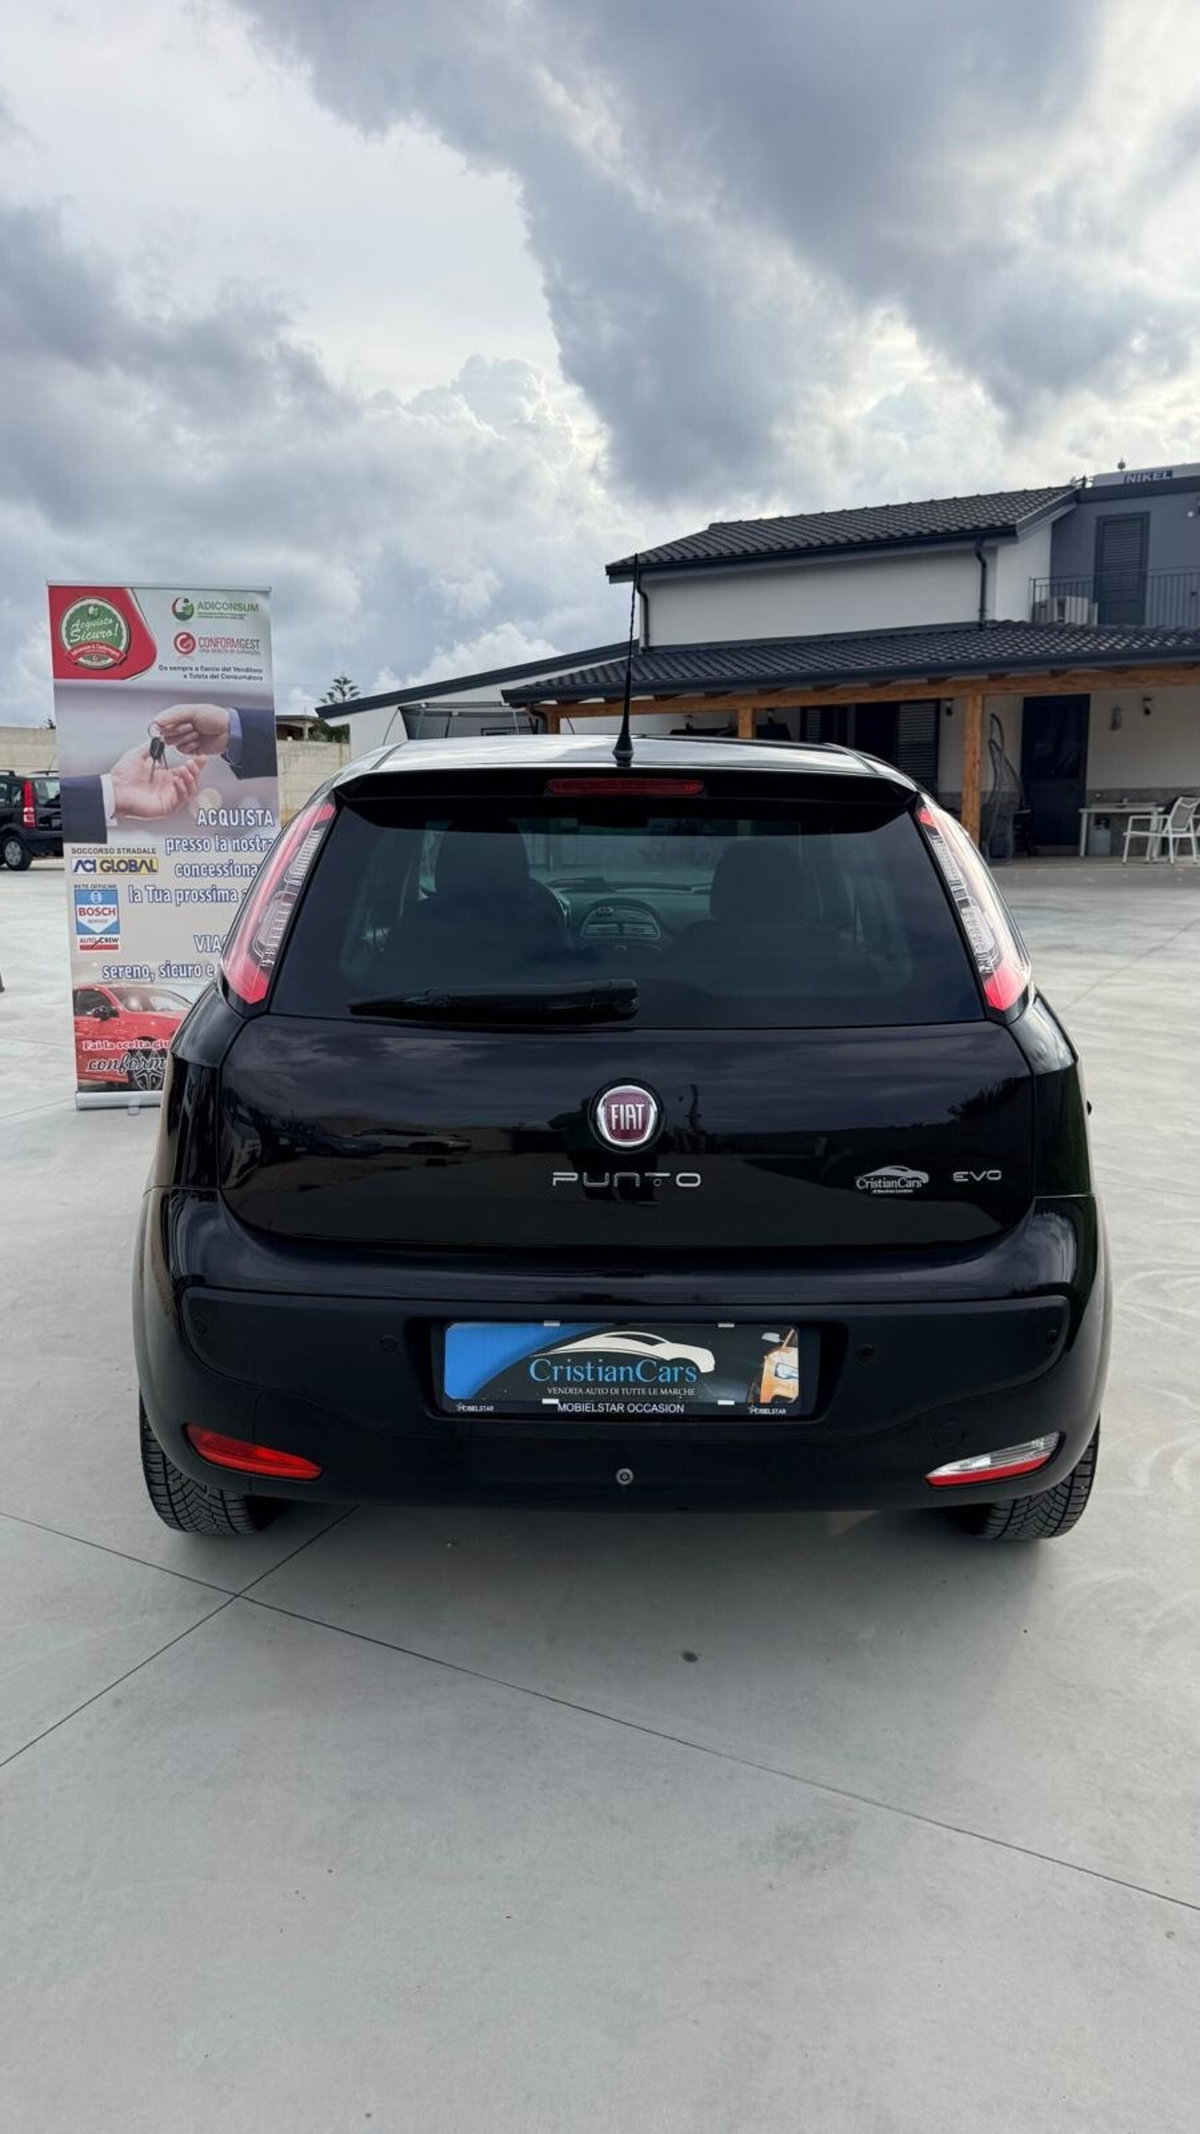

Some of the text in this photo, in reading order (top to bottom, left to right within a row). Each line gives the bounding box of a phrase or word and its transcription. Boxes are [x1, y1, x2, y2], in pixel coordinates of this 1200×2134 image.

[1124, 470, 1172, 483] NIKEL
[197, 601, 259, 613] ADICONSUM
[70, 618, 113, 632] Acquisto
[69, 622, 119, 643] Sicuro!
[198, 637, 260, 650] CONFORMGEST
[196, 808, 275, 827] ACQUISTA
[165, 837, 210, 855] presso
[215, 834, 228, 851] la
[73, 859, 158, 873] ACI GLOBAL
[128, 885, 144, 903] la
[145, 886, 173, 903] Tua
[175, 884, 239, 906] prossima
[78, 907, 116, 916] BOSCH
[193, 934, 226, 952] VIA
[102, 960, 215, 981] sereno, sicuro e
[83, 1040, 102, 1051] Fai
[104, 1040, 116, 1050] la
[117, 1040, 151, 1050] scelta
[610, 1103, 646, 1130] FIAT
[552, 1171, 702, 1188] PUNTO
[855, 1175, 923, 1189] CristianCars
[952, 1169, 1002, 1182] EVO
[529, 1357, 698, 1383] CristianCars
[547, 1386, 697, 1396] VENDITA AUTO DI TUTTE LE MARCHE
[557, 1402, 685, 1414] MOBIELSTAR OCCASION
